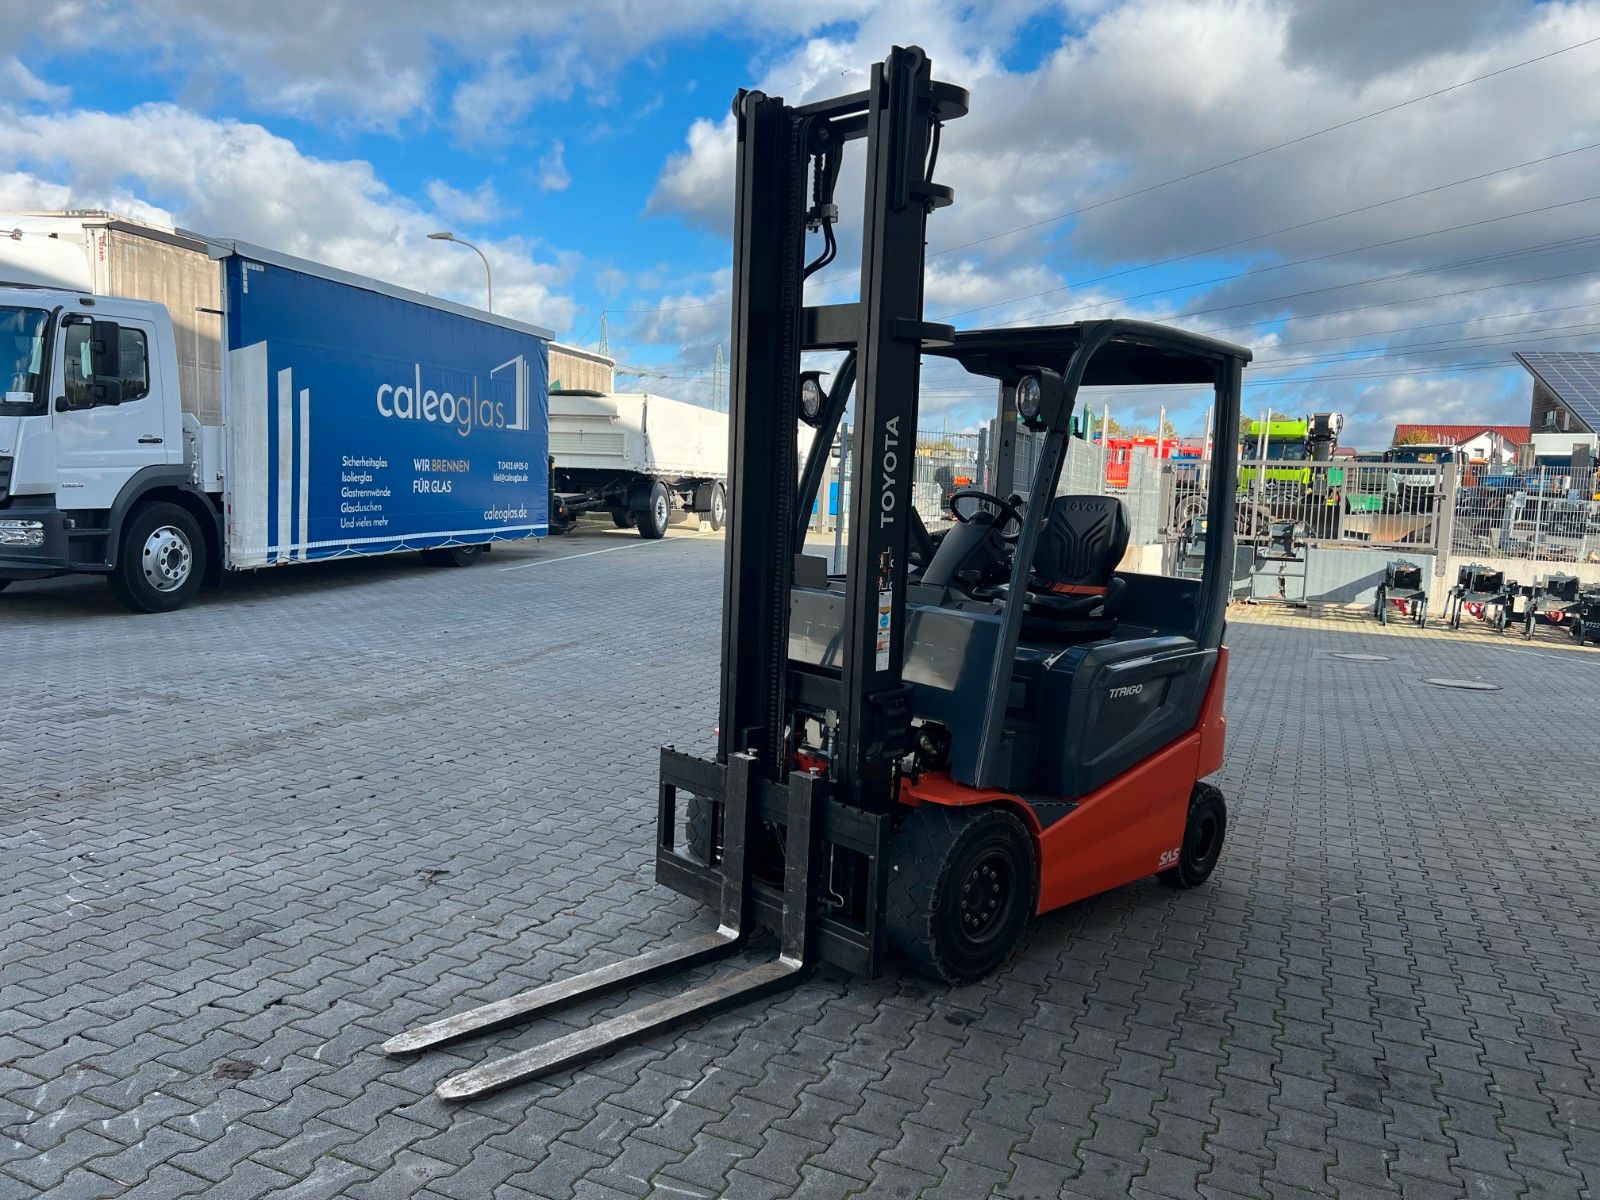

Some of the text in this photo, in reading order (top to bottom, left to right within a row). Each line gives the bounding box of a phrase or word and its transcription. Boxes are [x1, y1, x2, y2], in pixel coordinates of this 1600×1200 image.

[376, 363, 504, 437] caleoglas
[342, 455, 388, 470] Sicherheitsglas
[413, 458, 470, 472] WIR BRENNEN
[341, 470, 373, 485] Isolierglas
[880, 415, 900, 529] TOYOTA
[341, 485, 392, 498] Glastrennwände
[412, 477, 452, 494] FÜR GLAS
[340, 501, 383, 513] Glasduschen
[483, 503, 528, 523] caleoglas.de
[340, 515, 389, 529] Und vieles mehr
[1158, 847, 1180, 867] SAS
